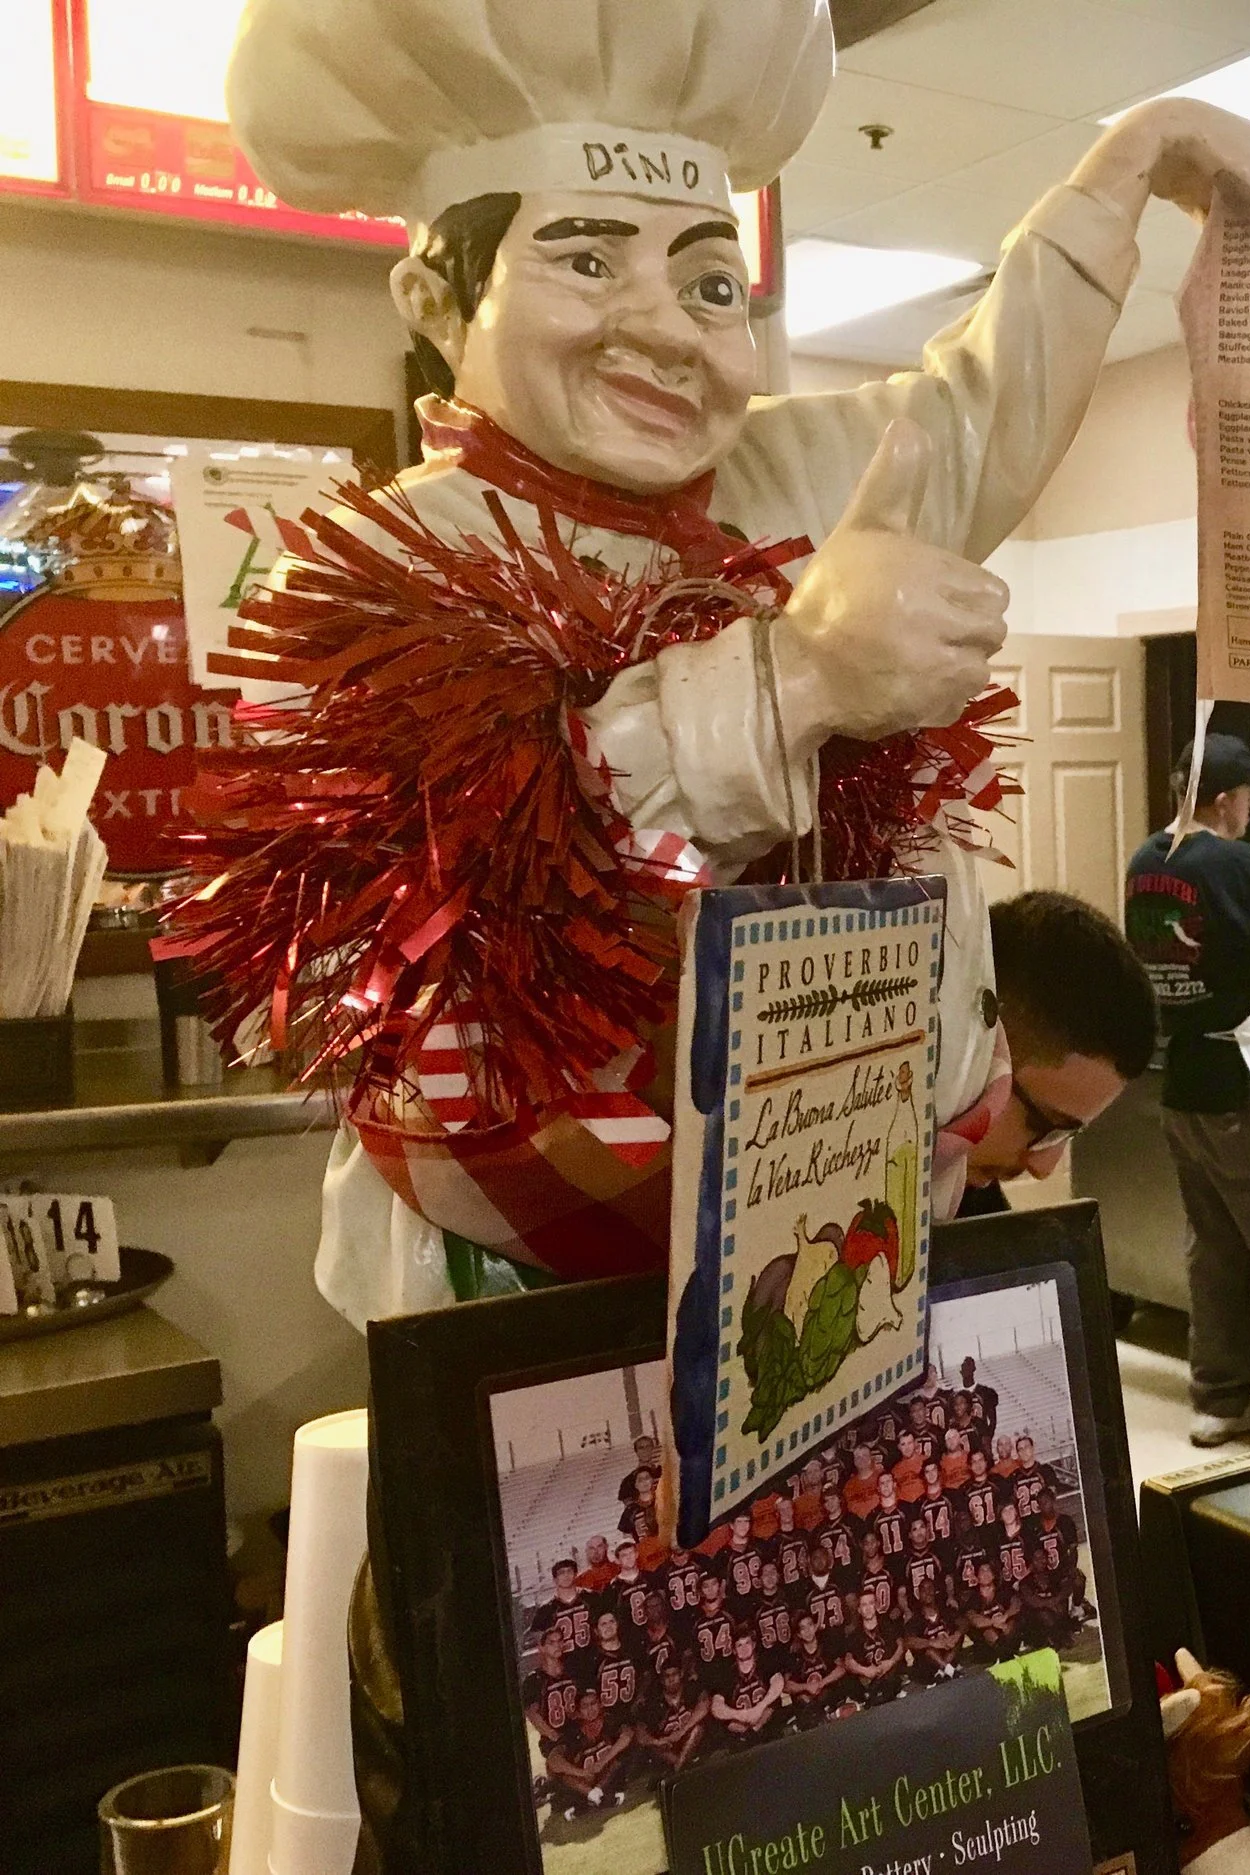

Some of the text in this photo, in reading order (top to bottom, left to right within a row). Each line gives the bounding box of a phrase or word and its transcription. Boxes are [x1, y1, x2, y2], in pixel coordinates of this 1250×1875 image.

[1218, 318, 1248, 328] Baked
[1218, 343, 1250, 352] Stuffed
[25, 633, 179, 665] CERVE
[1231, 635, 1250, 647] Ham
[0, 679, 240, 756] Coron
[758, 940, 920, 994] PROVERBIO
[755, 1000, 918, 1065] ITALIANO
[744, 1096, 779, 1151] La
[780, 1087, 835, 1138] Buona
[834, 1064, 886, 1121] Salute
[745, 1120, 882, 1209] la Vera Ricchezza
[47, 1199, 102, 1254] 14
[968, 1493, 996, 1528] 61
[880, 1519, 904, 1554] 11
[669, 1571, 701, 1611] 33
[557, 1611, 591, 1654] 25
[759, 1612, 792, 1649] 56
[811, 1595, 844, 1630] 73
[698, 1624, 733, 1663] 34
[601, 1666, 637, 1708] 53
[839, 1796, 884, 1850] Art
[893, 1768, 994, 1829] Center,
[1000, 1725, 1063, 1789] LLC.
[952, 1811, 1041, 1863] Sculpting
